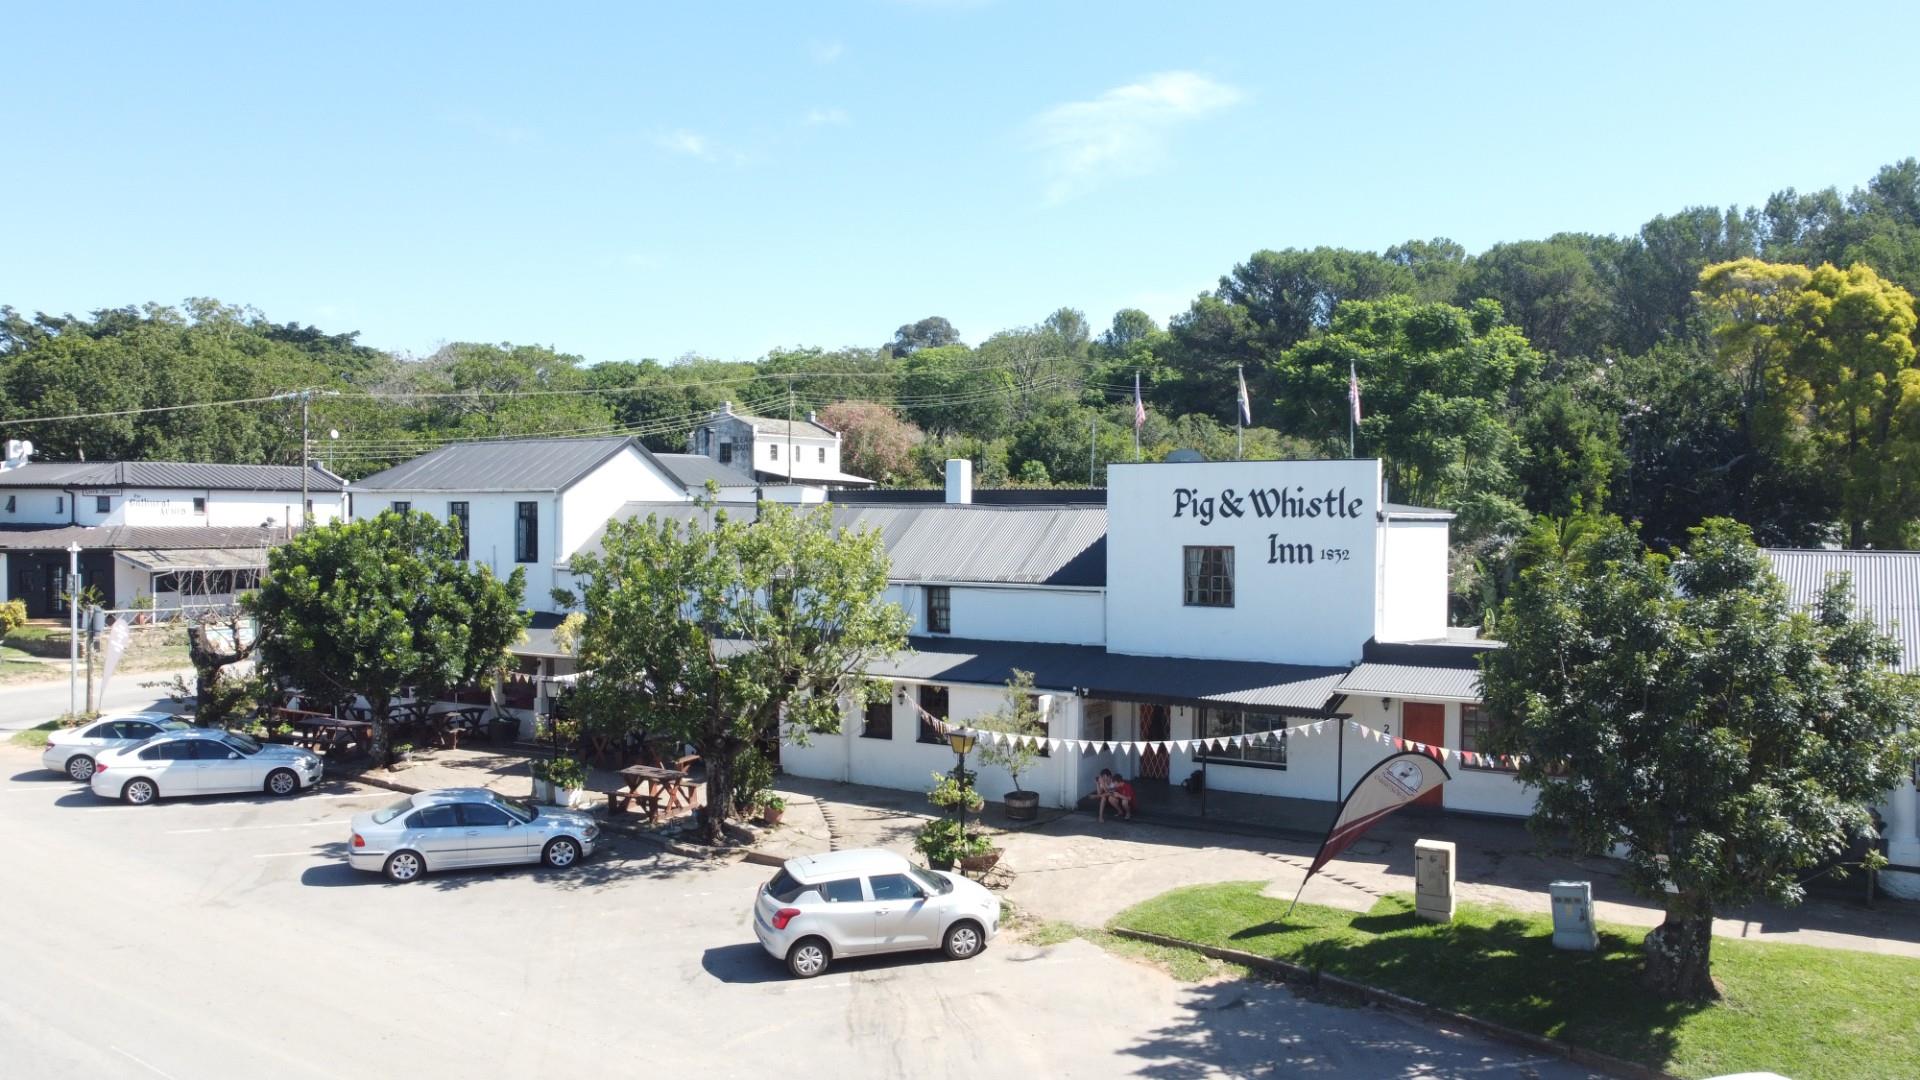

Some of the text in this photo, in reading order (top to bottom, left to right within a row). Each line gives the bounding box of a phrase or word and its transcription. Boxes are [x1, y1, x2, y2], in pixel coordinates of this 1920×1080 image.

[1173, 486, 1363, 526] Pig & Whistle
[1267, 533, 1350, 564] Inn 1832
[1383, 724, 1390, 734] 2
